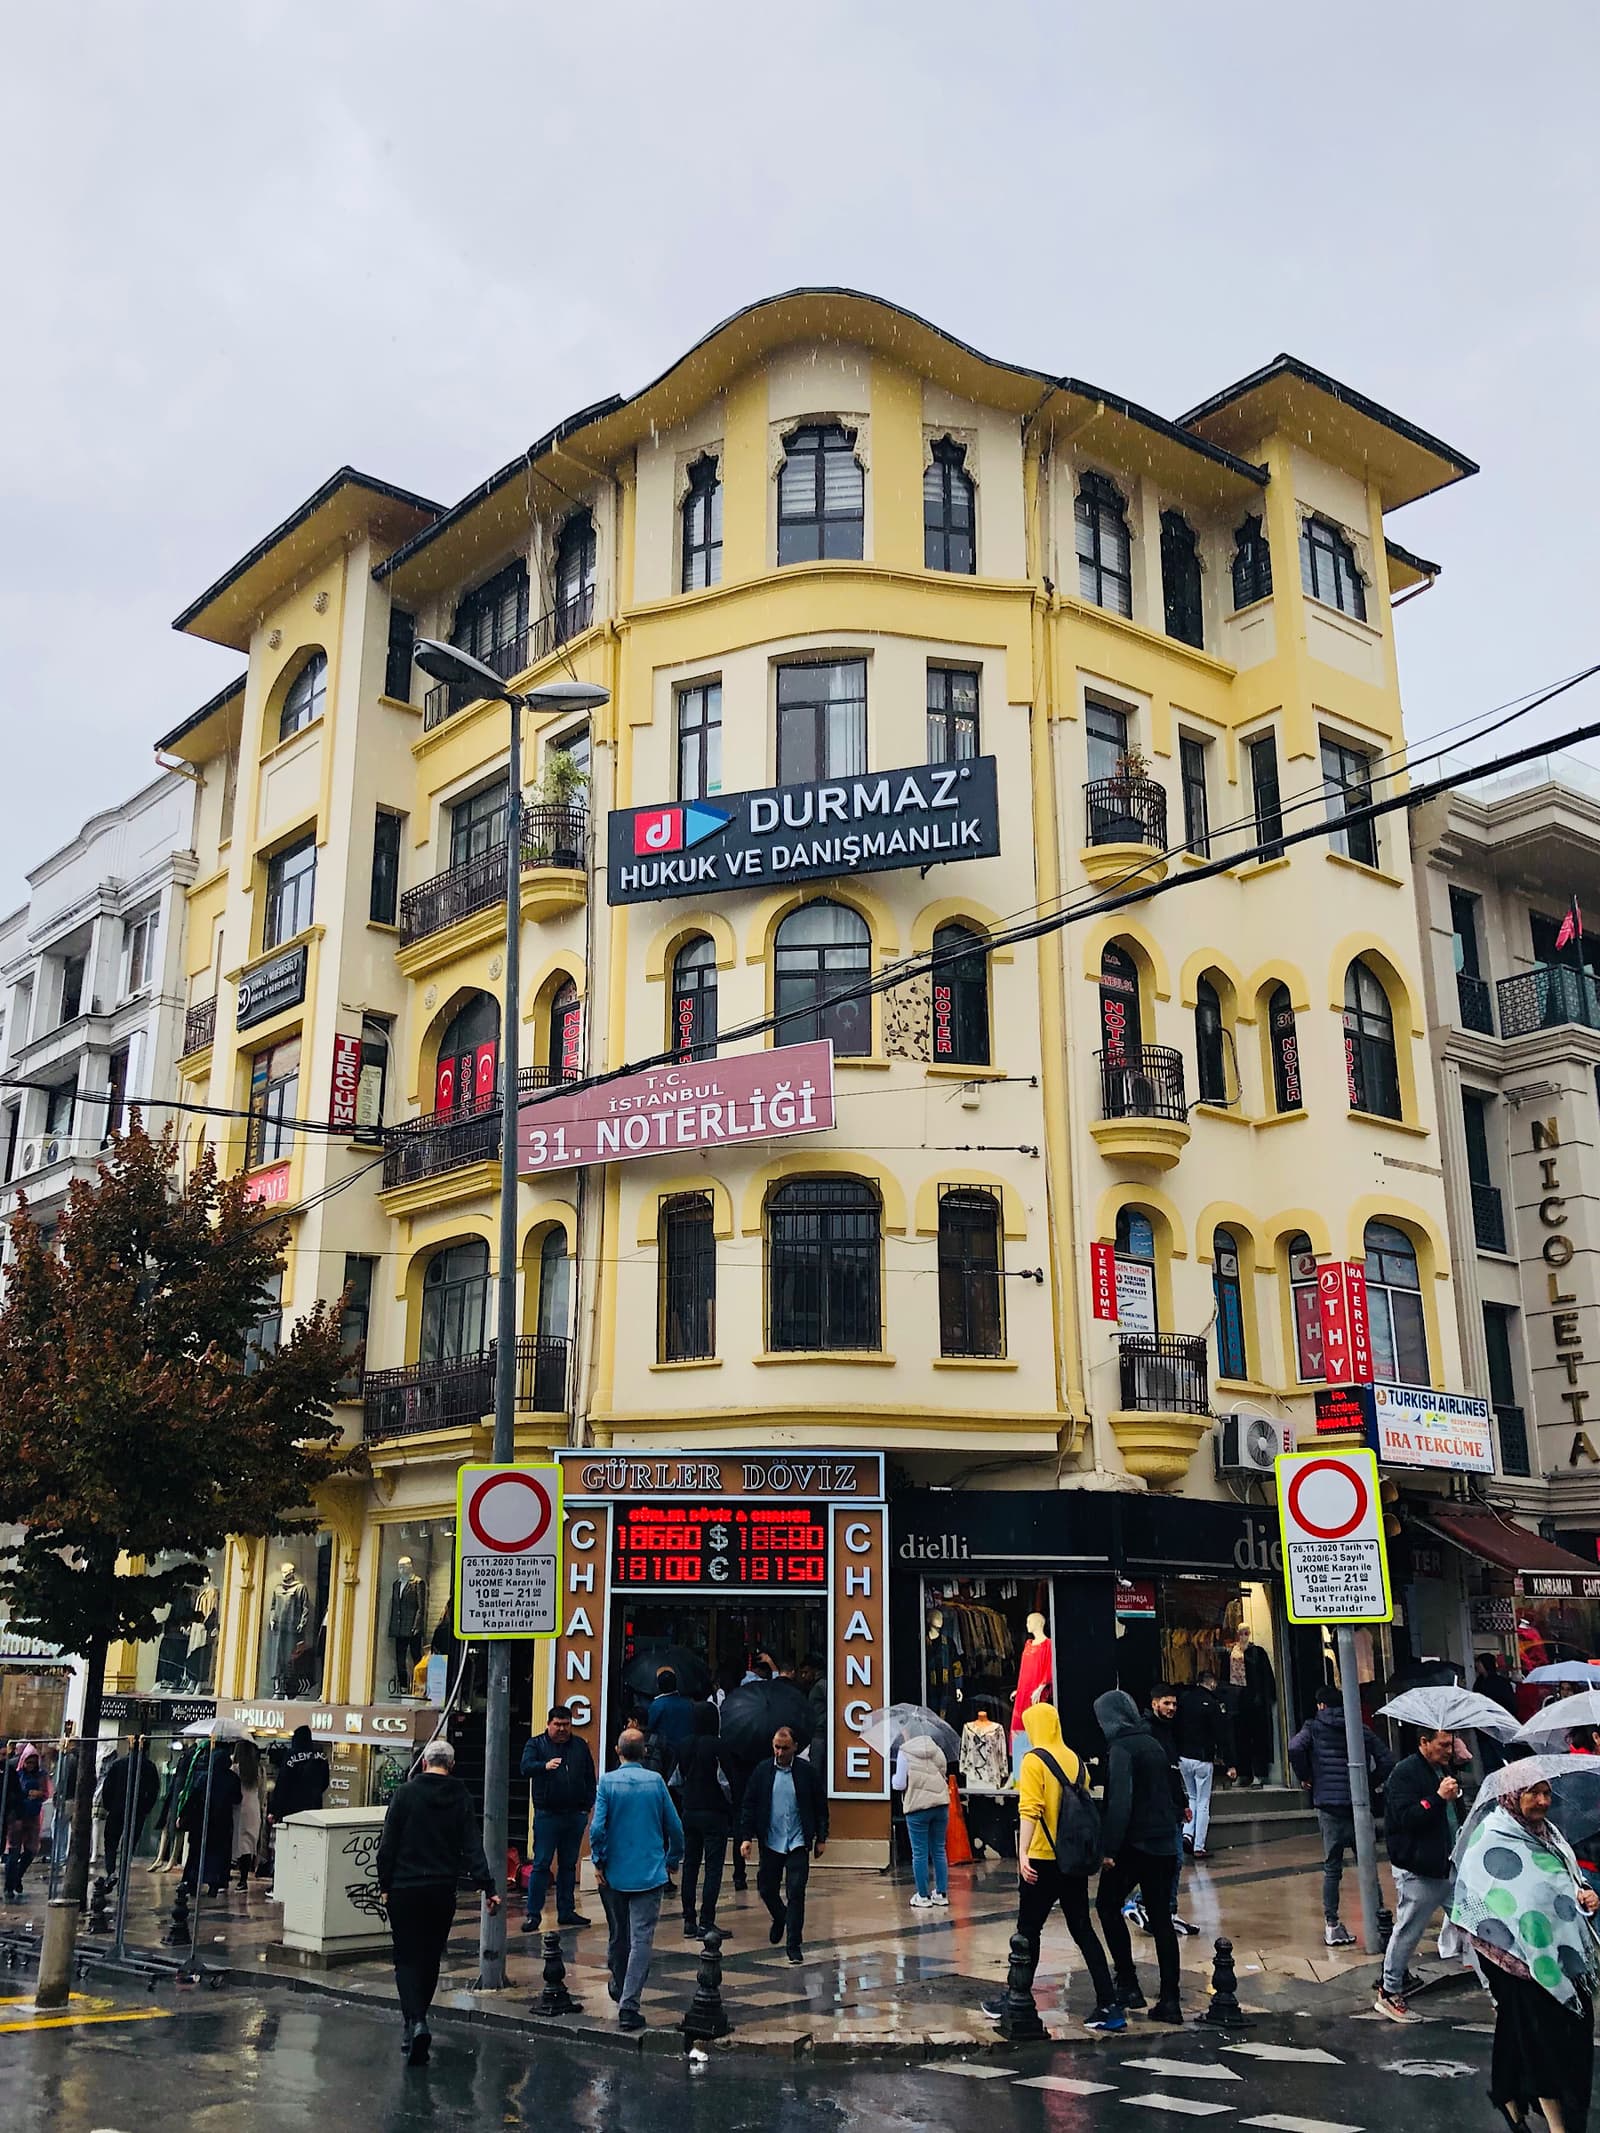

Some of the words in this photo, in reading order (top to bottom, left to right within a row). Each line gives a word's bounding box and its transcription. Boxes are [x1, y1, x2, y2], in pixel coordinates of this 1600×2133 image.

[619, 855, 716, 890] HUKUK
[727, 848, 761, 874] VE
[771, 818, 982, 869] DANIŞMANLIK
[935, 986, 952, 1053] NOTER
[645, 1071, 687, 1090] T.C.
[1282, 1036, 1300, 1102] NOTER
[1344, 1038, 1357, 1104] NOTER
[608, 1081, 725, 1113] İSTANBUL
[527, 1126, 582, 1166] 31.
[596, 1079, 818, 1157] NOTERLİĞİ
[1531, 1116, 1600, 1466] NICOLETTA
[1304, 1293, 1322, 1369] THY
[1325, 1299, 1344, 1375] THY
[1388, 1390, 1437, 1412] TURKISH
[1438, 1398, 1487, 1418] AIRLINES
[1385, 1428, 1413, 1449] İRA
[1415, 1435, 1484, 1458] TERCÜME
[580, 1457, 722, 1490] GÜRLER
[743, 1458, 858, 1491] DÖVİZ
[629, 1506, 687, 1522] GÜRLER
[617, 1525, 701, 1550] 18660
[738, 1526, 824, 1550] 18680
[899, 1534, 970, 1560] dielli
[1232, 1519, 1283, 1573] die
[1293, 1543, 1338, 1553] 26.11.2020
[1340, 1543, 1361, 1551] Tarih
[467, 1558, 514, 1567] 26.11.2020
[517, 1558, 538, 1566] Tarih
[617, 1556, 701, 1580] 18100
[738, 1556, 824, 1581] 18150
[1296, 1564, 1330, 1573] UKOME
[1361, 1563, 1372, 1571] ile
[1302, 1554, 1338, 1563] 2020/6-3
[1340, 1553, 1365, 1562] Sayılı
[468, 1579, 503, 1587] UKOME
[475, 1568, 513, 1577] 2020/6-3
[515, 1568, 540, 1578] Sayılı
[1300, 1595, 1326, 1603] Taşıt
[1328, 1594, 1377, 1603] Trafiğine
[1308, 1584, 1341, 1593] Saatleri
[1343, 1584, 1367, 1592] Arası
[1533, 1577, 1573, 1595] KAHRAMAN
[1582, 1578, 1600, 1597] ÇANT
[469, 1610, 495, 1618] Taşıt
[478, 1599, 513, 1608] Saatleri
[515, 1599, 539, 1607] Arası
[1314, 1604, 1364, 1613] Kapalıdır
[483, 1620, 534, 1629] Kapalıdır
[564, 1520, 597, 1727] CHANG
[843, 1521, 874, 1780] CHANGE
[234, 1708, 284, 1729] EPSILON
[372, 1717, 408, 1733] CCS
